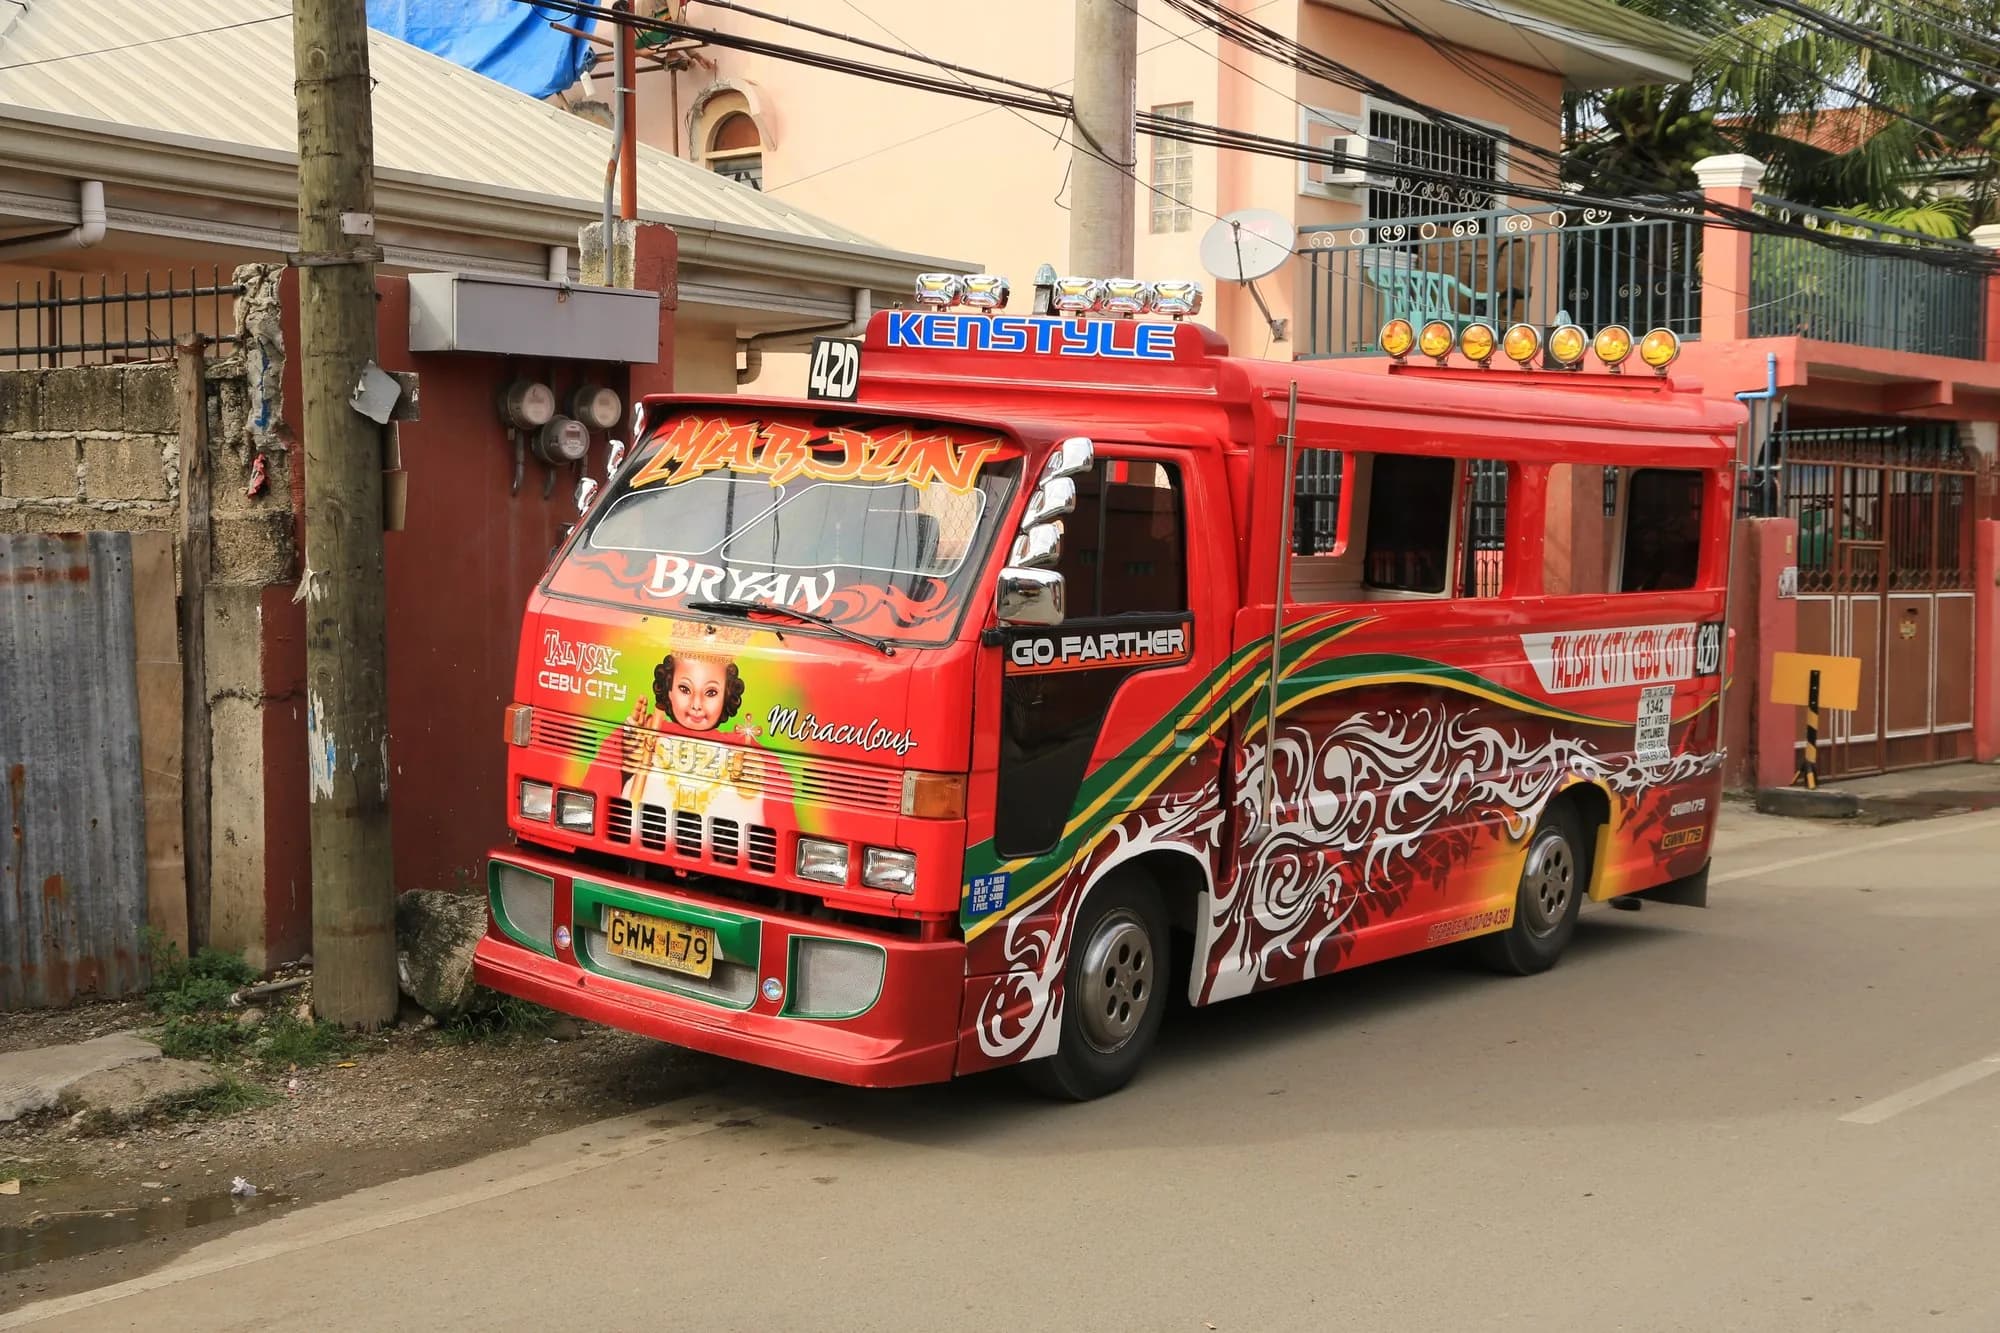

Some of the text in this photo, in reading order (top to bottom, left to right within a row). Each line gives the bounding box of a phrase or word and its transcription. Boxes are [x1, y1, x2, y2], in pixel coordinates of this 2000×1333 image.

[887, 311, 1177, 361] KENSTYLE
[810, 341, 860, 399] 42D
[629, 415, 1003, 495] MARJUN
[642, 553, 836, 614] BRYAN
[544, 628, 622, 675] TALISAY
[1011, 628, 1185, 666] GO FARTHER
[1552, 626, 1695, 690] TALISAY CITY CEBU CITY
[538, 670, 627, 702] CEBU CITY
[1646, 699, 1664, 714] 1342
[766, 703, 919, 756] Miraculous
[1638, 716, 1651, 728] TEXT
[1654, 714, 1669, 726] VIBER
[612, 918, 656, 954] GWM
[665, 930, 708, 966] 179
